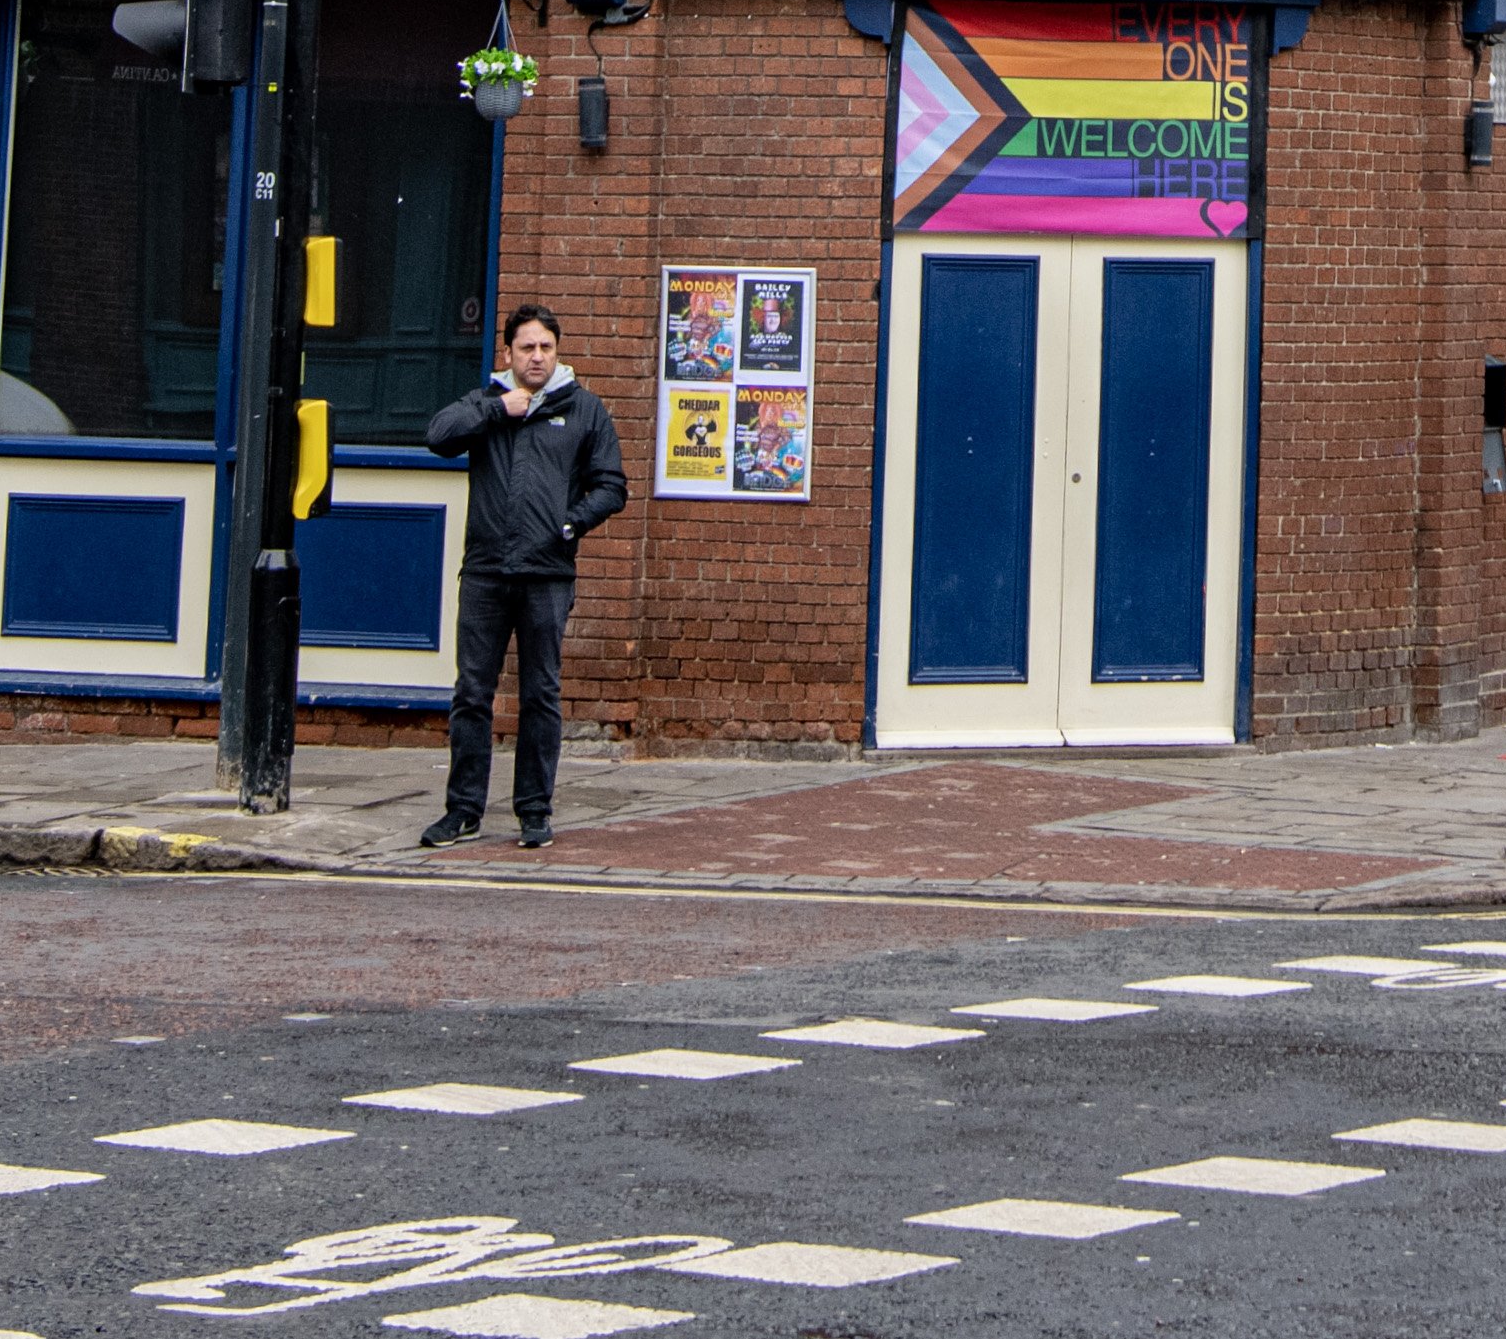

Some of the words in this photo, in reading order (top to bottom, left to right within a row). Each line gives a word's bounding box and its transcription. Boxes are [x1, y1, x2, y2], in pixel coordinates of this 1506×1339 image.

[1113, 2, 1246, 44] EVERY
[1164, 41, 1249, 82] ONE
[1214, 81, 1249, 123] IS
[1041, 119, 1249, 160] WELCOME
[256, 171, 276, 189] 20
[1133, 158, 1249, 201] HERE
[255, 188, 274, 200] C11
[669, 280, 736, 293] MONDAY
[755, 283, 792, 292] BAILEY
[737, 389, 807, 402] MONDAY
[678, 398, 721, 411] CHEDDAR
[672, 444, 722, 458] GORGEOUS
